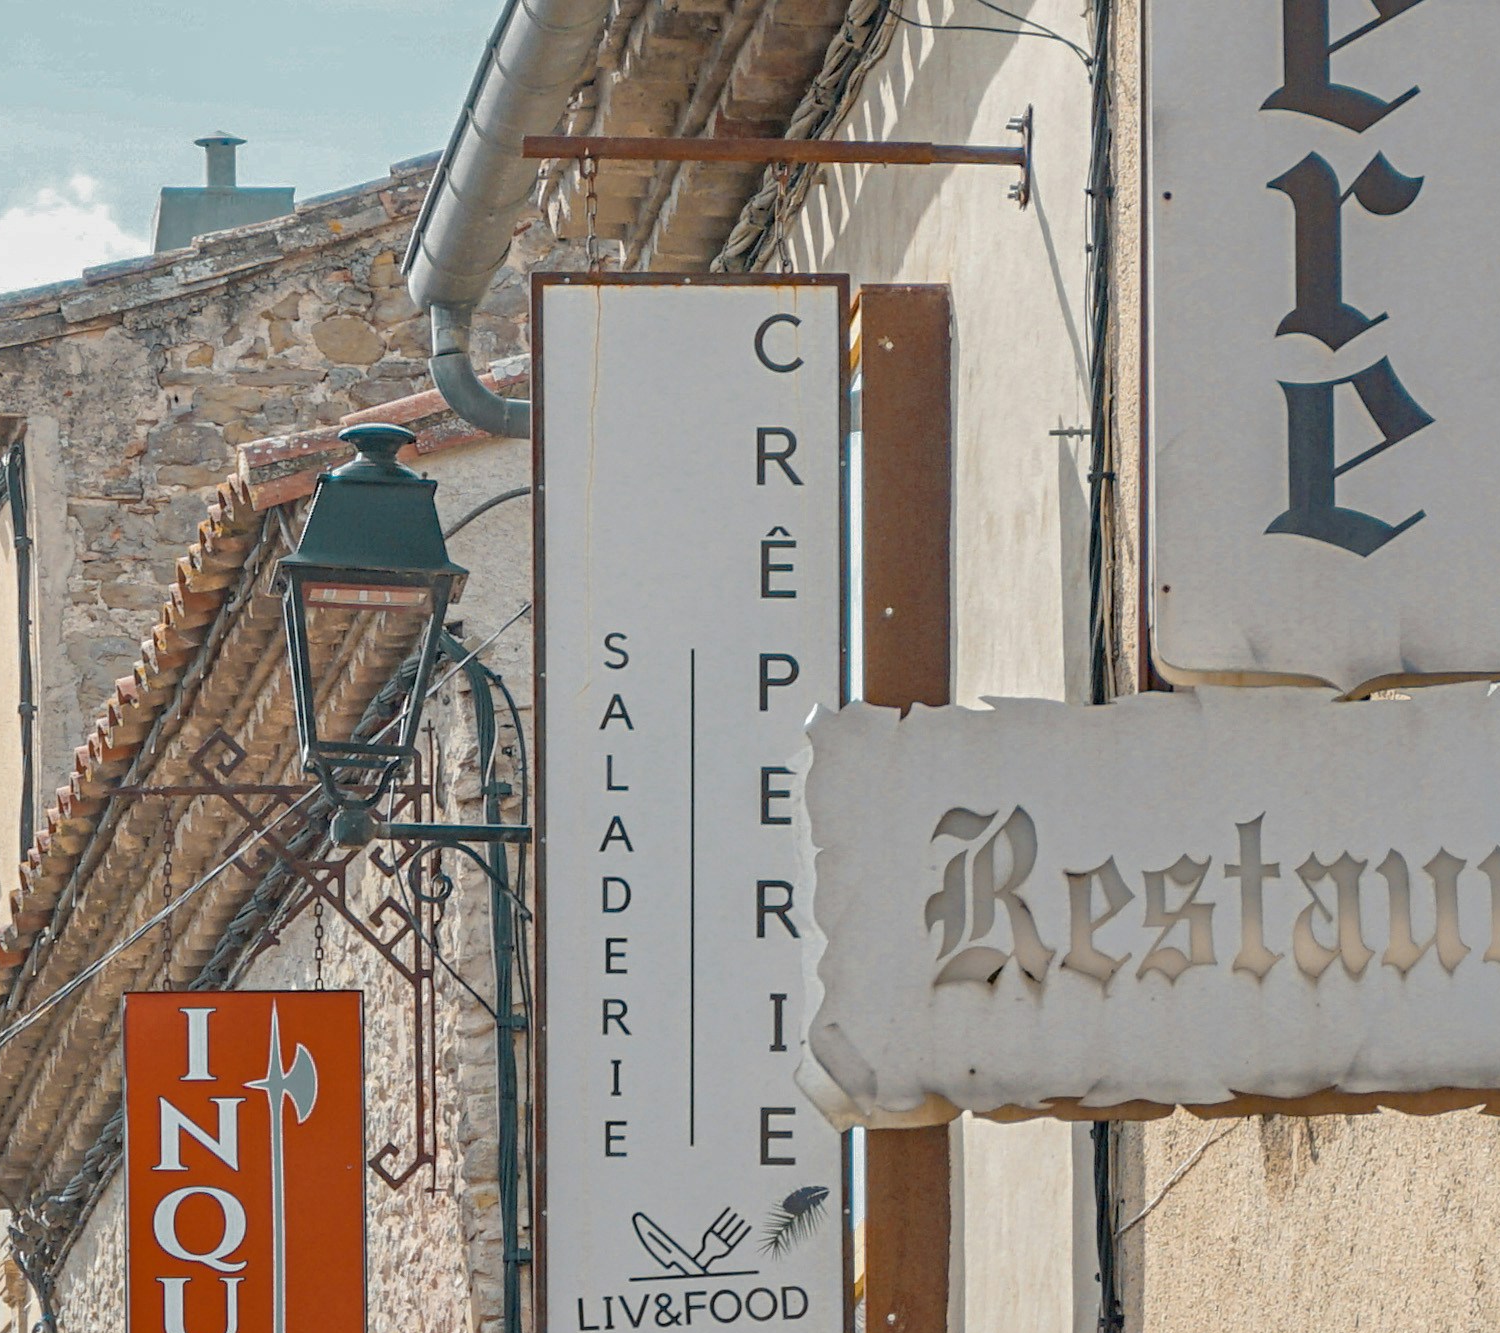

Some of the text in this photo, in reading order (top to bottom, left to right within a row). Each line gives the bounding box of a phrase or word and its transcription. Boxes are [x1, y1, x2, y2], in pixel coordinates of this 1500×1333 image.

[598, 631, 636, 1159] SALADERIE
[753, 312, 804, 1167] CRÊPERIE
[576, 1284, 810, 1333] LIV&FOOD
